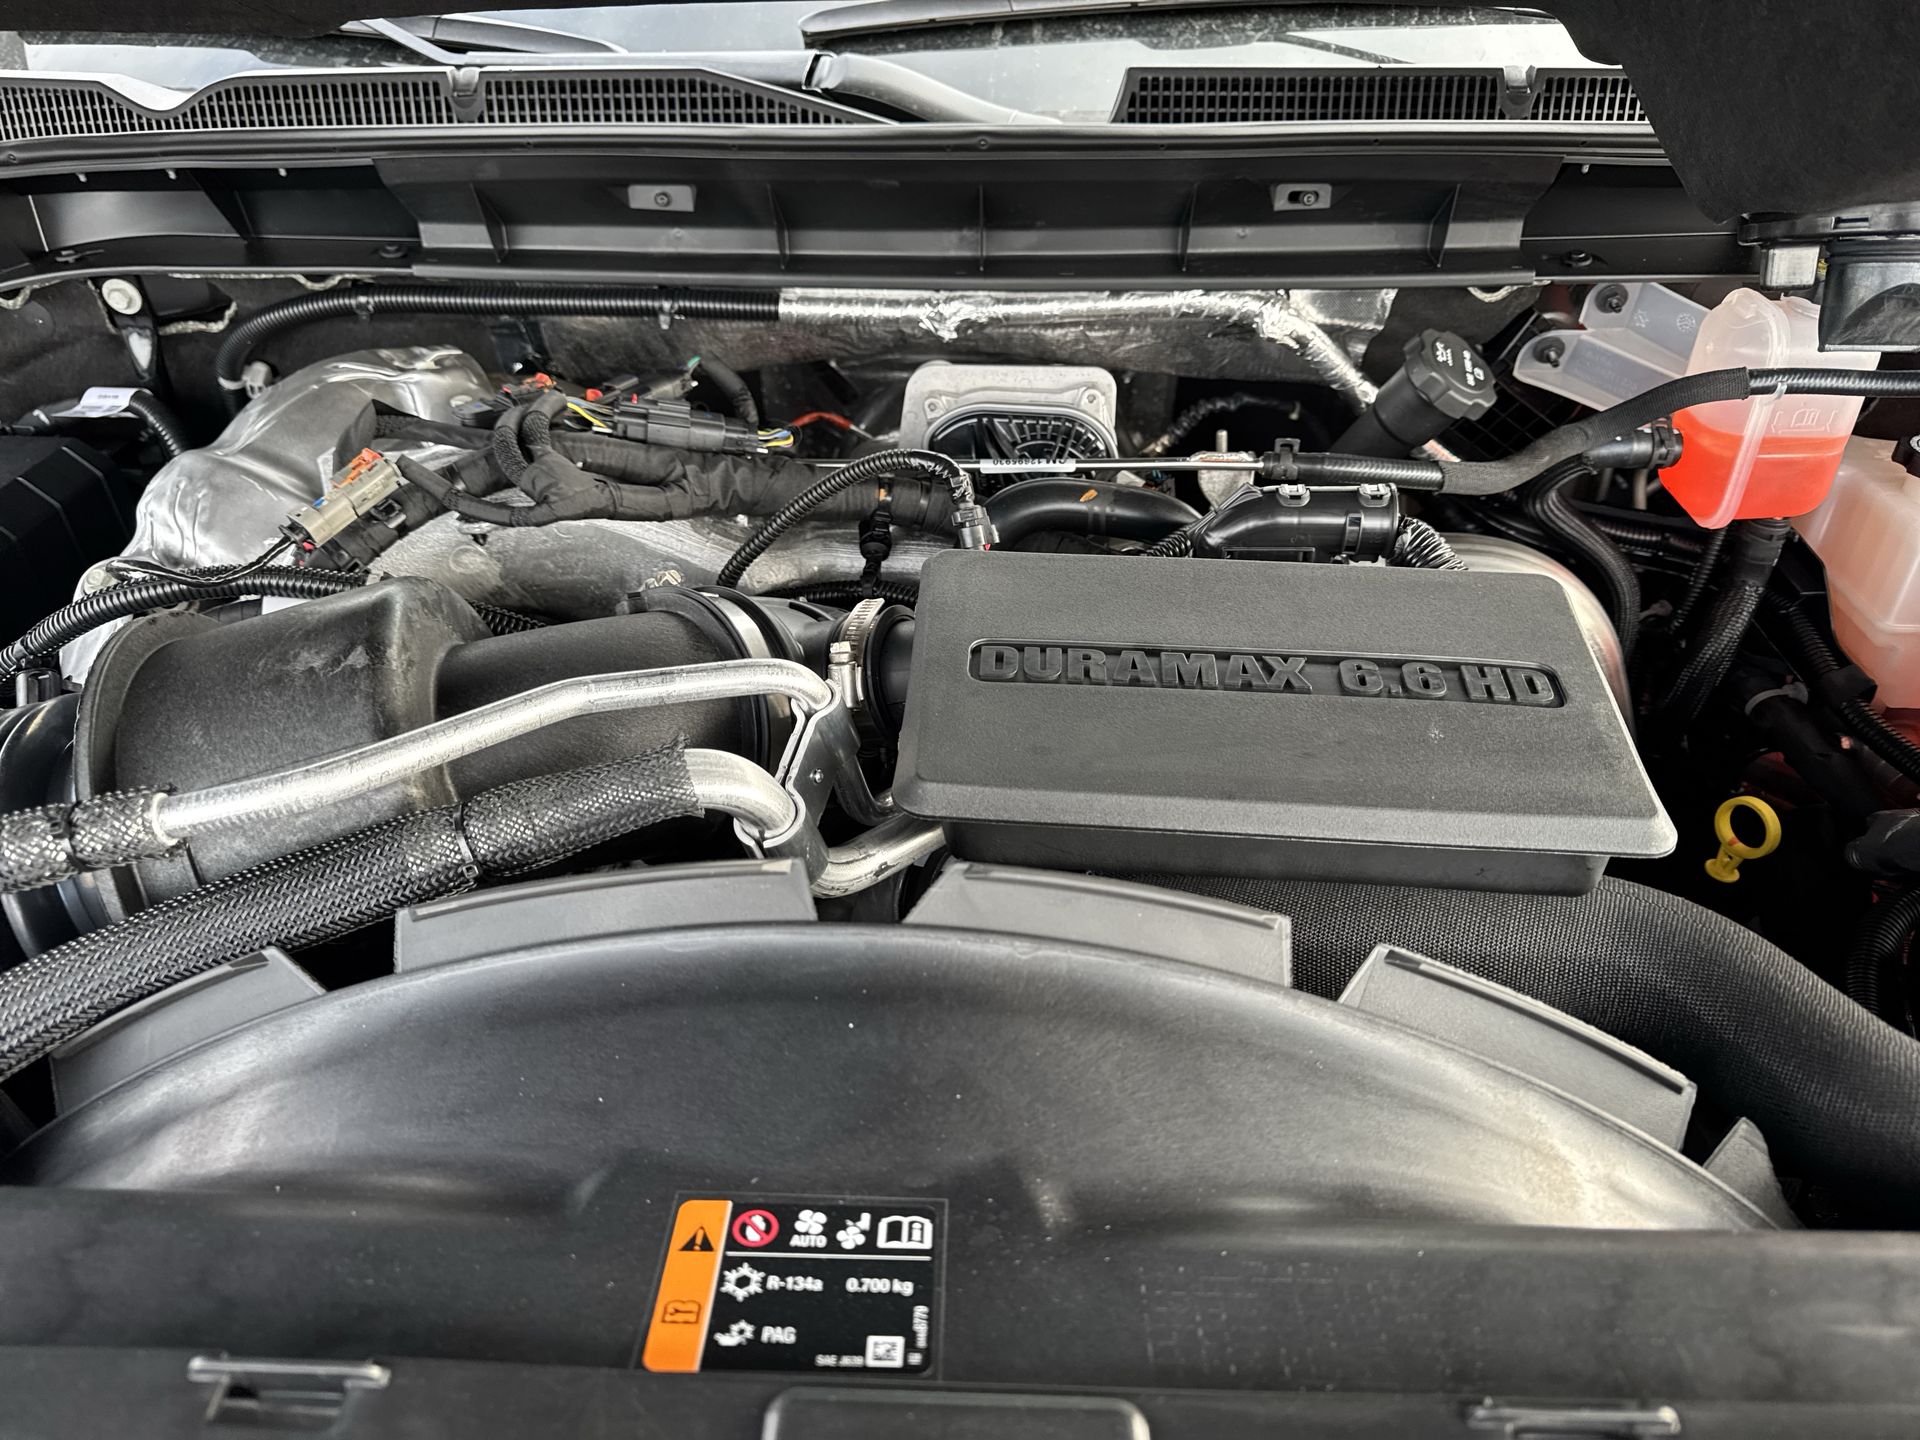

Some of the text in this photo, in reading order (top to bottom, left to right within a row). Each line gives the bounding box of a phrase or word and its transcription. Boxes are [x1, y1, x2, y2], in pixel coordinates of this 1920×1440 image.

[979, 645, 1554, 701] DURAMAX 6.6 HD
[789, 1234, 828, 1249] AUTO
[766, 1274, 915, 1297] R-134a 0.700 kg
[761, 1326, 797, 1345] PAG
[815, 1354, 838, 1367] SAE
